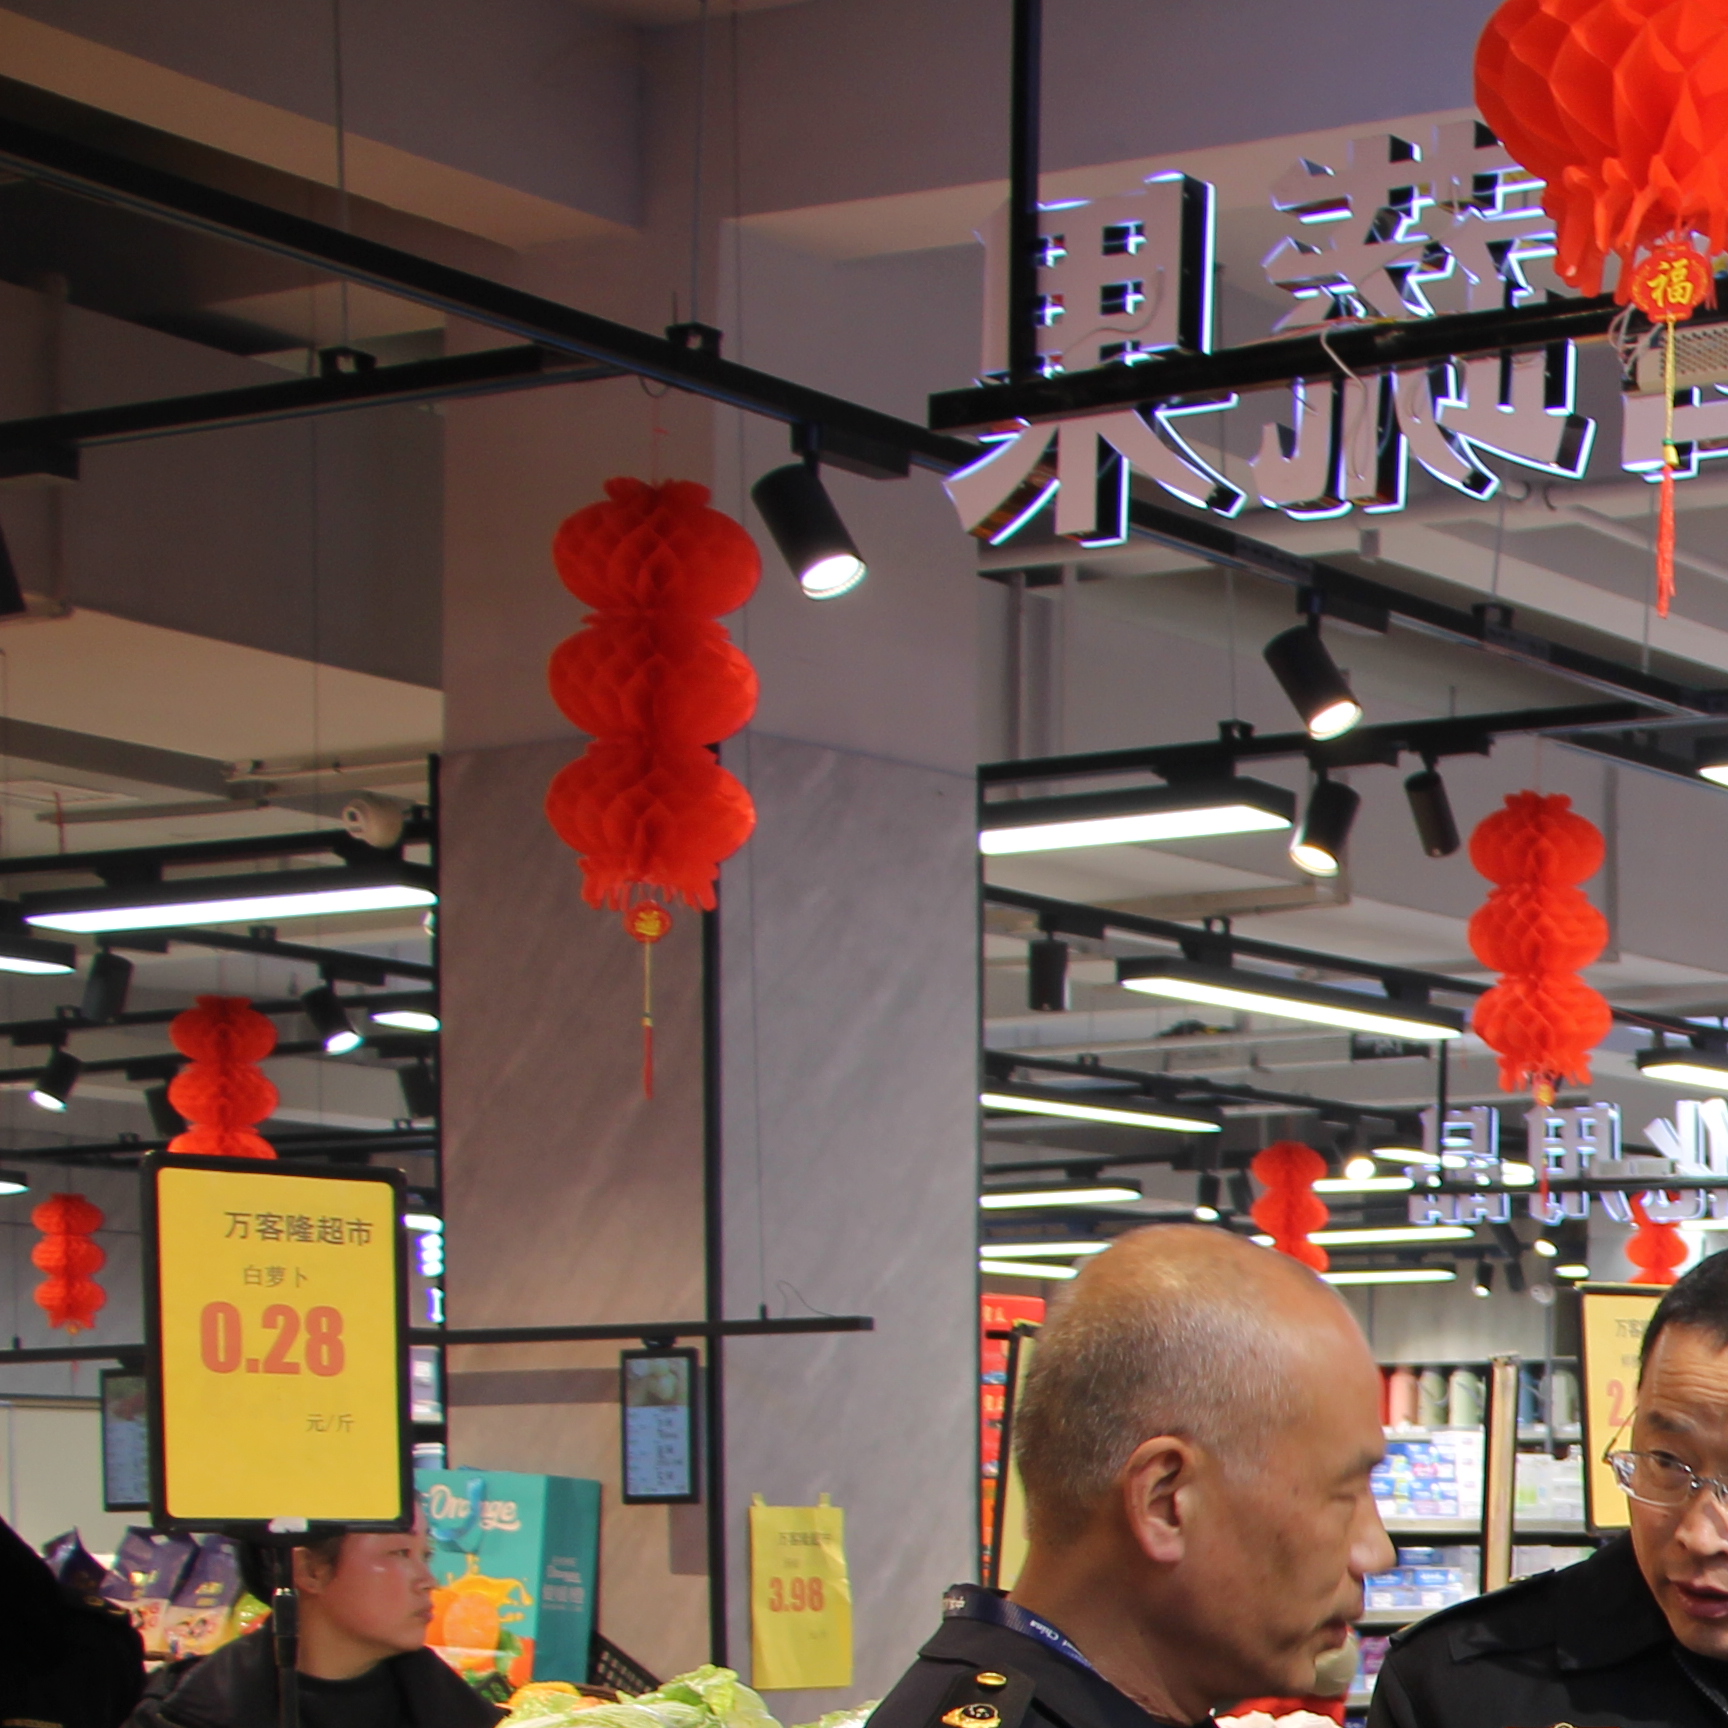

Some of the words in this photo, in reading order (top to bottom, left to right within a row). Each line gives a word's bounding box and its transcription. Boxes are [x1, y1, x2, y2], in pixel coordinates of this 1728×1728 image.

[224, 211, 373, 246] 万客隆超市
[243, 265, 308, 288] 白萝卜
[1647, 257, 1695, 308] 福
[201, 301, 346, 377] 0.28
[306, 413, 355, 433] 元/斤
[769, 1577, 825, 1613] 3.98
